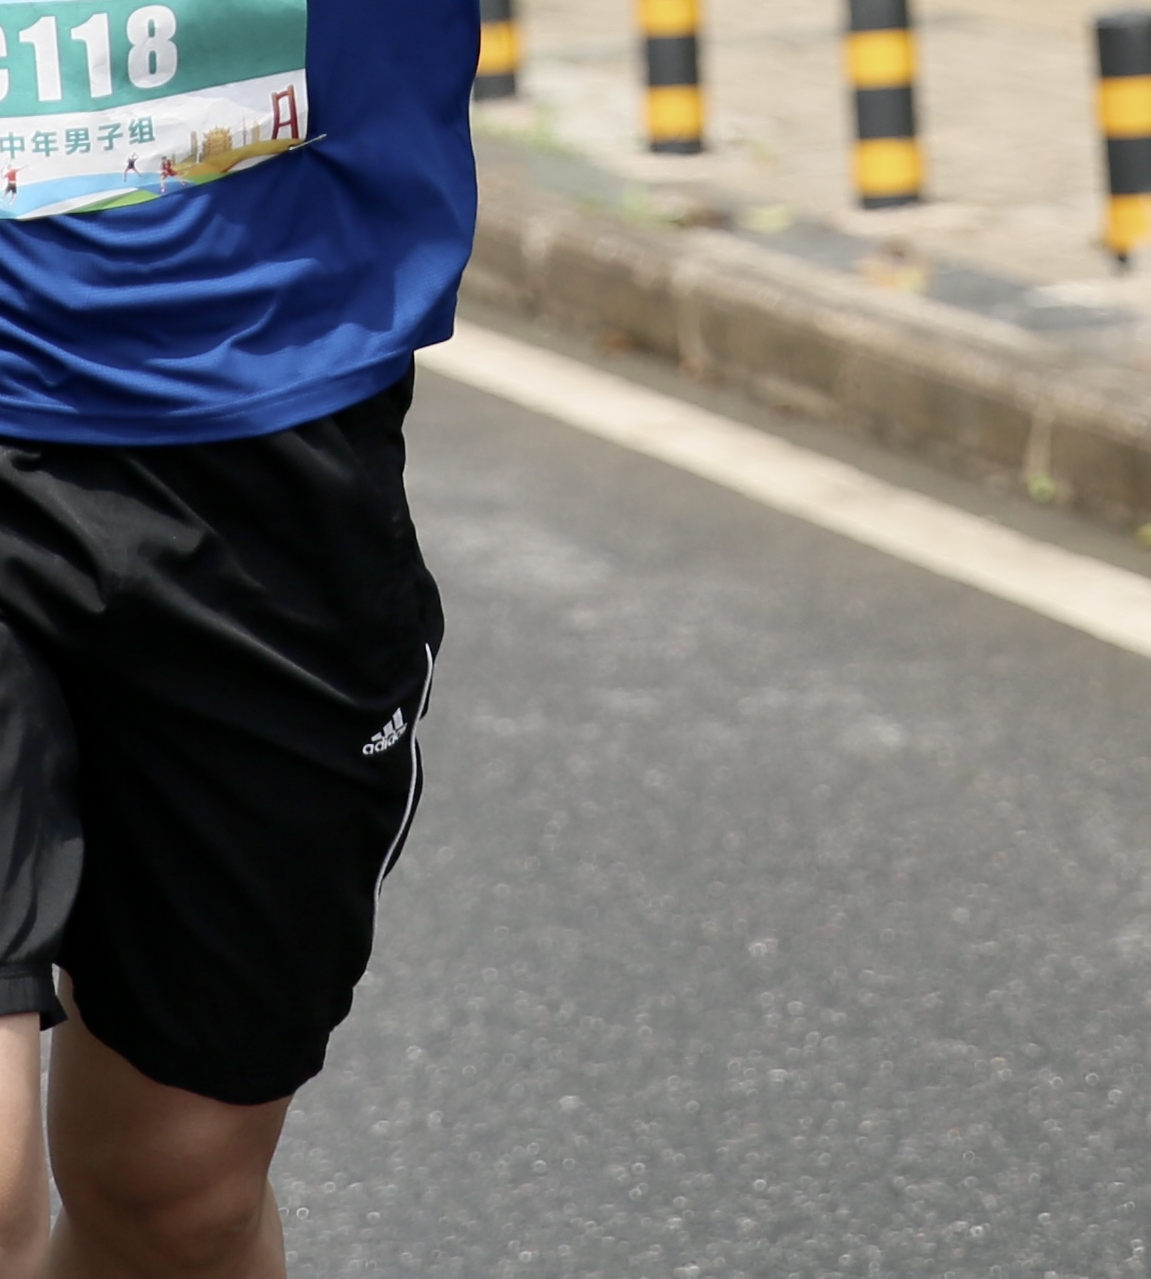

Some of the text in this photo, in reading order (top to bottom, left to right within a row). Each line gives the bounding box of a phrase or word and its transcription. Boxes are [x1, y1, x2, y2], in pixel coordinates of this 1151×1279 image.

[0, 116, 155, 159] 中年男子组
